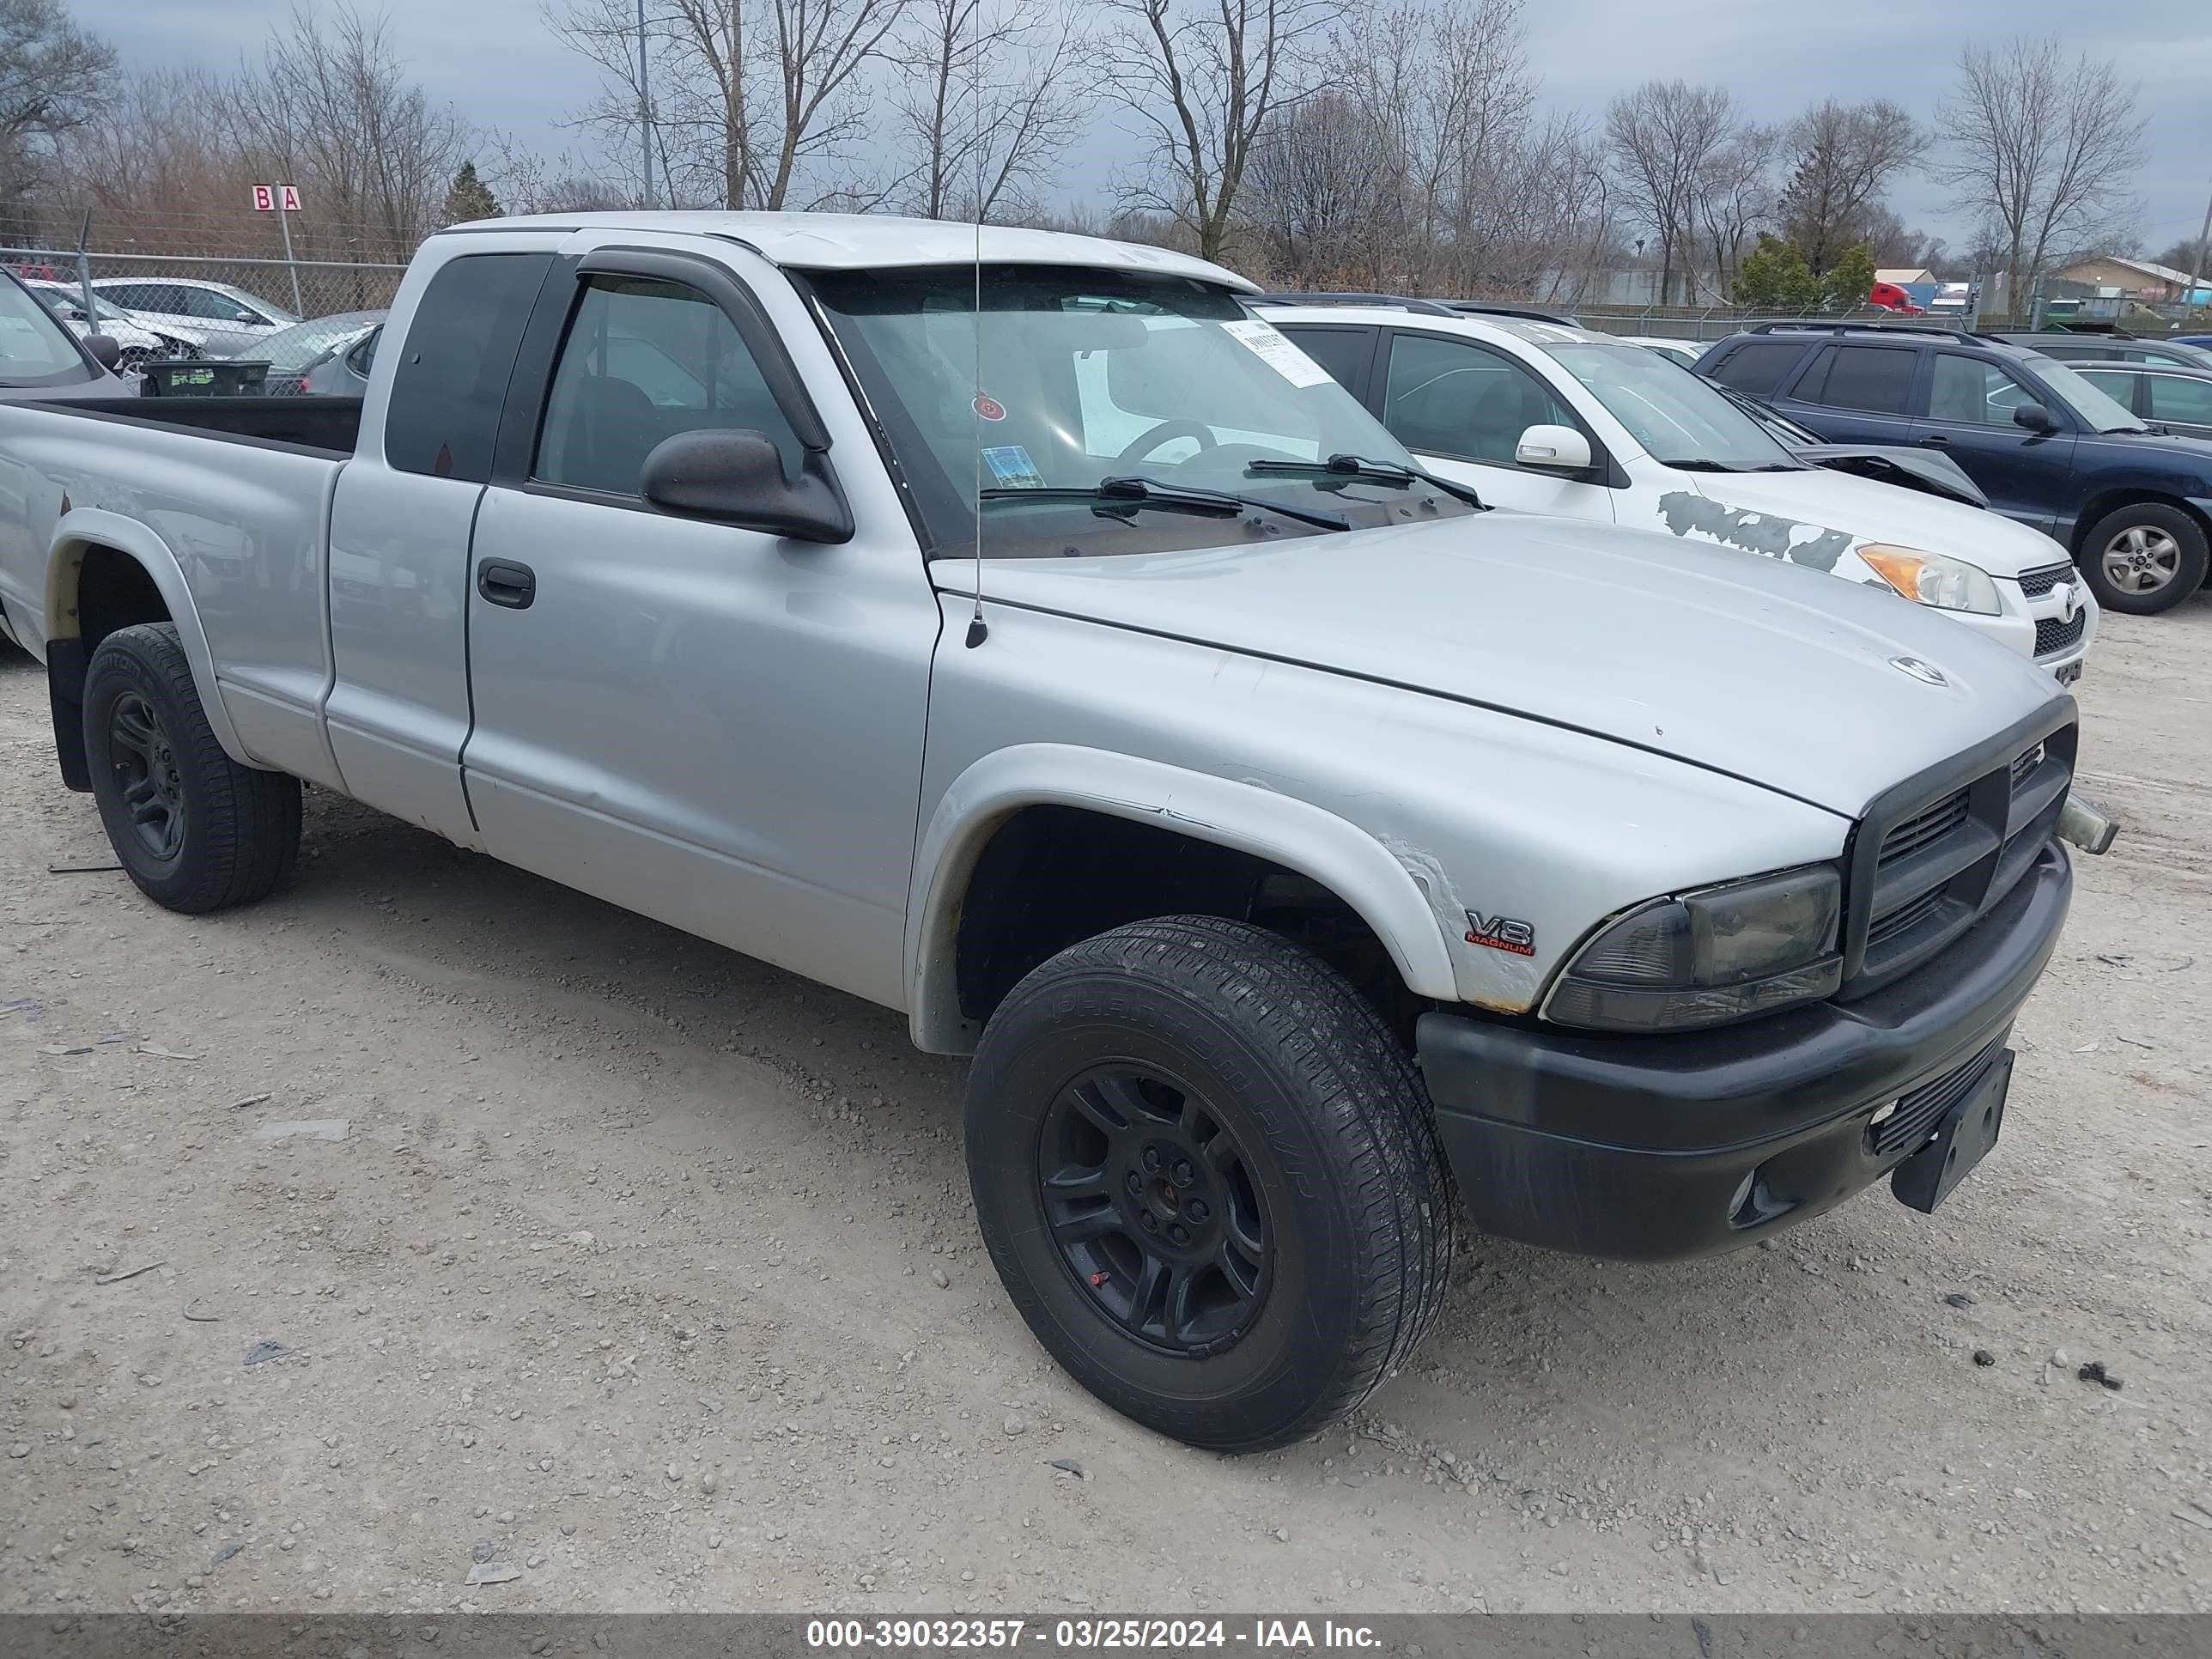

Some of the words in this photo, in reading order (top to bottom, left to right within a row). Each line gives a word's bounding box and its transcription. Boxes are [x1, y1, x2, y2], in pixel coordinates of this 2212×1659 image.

[256, 187, 270, 209] B
[285, 187, 299, 209] A
[1465, 909, 1534, 945] V8
[1467, 933, 1533, 955] MAGNUM
